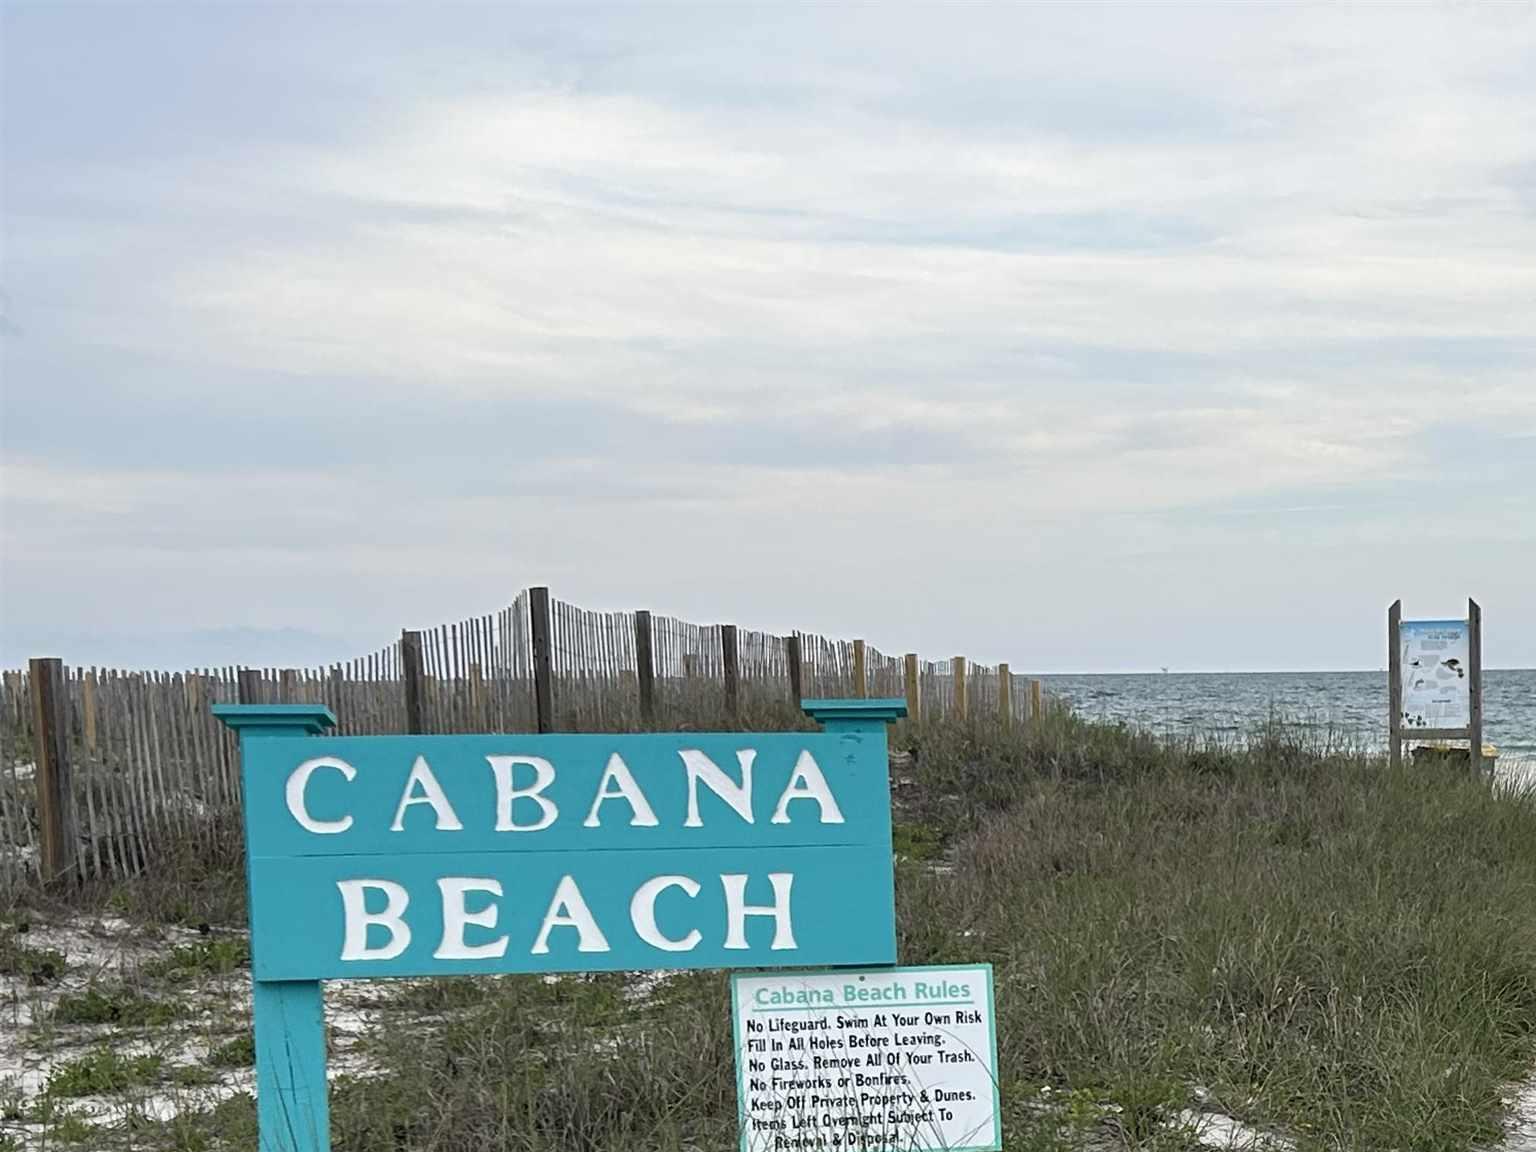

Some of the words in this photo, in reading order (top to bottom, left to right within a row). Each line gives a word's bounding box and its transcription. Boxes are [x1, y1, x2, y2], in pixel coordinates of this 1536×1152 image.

[285, 749, 845, 835] CABANA
[336, 872, 798, 962] BEACH
[754, 986, 834, 1006] Cabana
[844, 982, 906, 1002] Beach
[915, 980, 970, 1000] Rules
[747, 1019, 764, 1033] No
[768, 1016, 831, 1034] Lifeguard.
[837, 1014, 869, 1029] Swim
[874, 1013, 887, 1027] At
[892, 1012, 919, 1027] Your
[925, 1011, 950, 1025] Own
[956, 1010, 982, 1024] Risk
[748, 1037, 766, 1052] Fill
[771, 1036, 783, 1051] In
[788, 1035, 804, 1050] All
[809, 1034, 843, 1049] Holes
[849, 1033, 889, 1048] Before
[894, 1032, 946, 1047] Leaving.
[749, 1058, 765, 1072] No
[771, 1056, 809, 1071] Glass.
[814, 1055, 861, 1070] Remove
[866, 1053, 882, 1067] All
[886, 1052, 901, 1066] Of
[906, 1051, 933, 1065] Your
[938, 1049, 975, 1063] Trash.
[750, 1078, 767, 1092] No
[772, 1074, 832, 1091] Fireworks
[837, 1076, 850, 1088] or
[856, 1072, 911, 1087] Bonfires.
[752, 1097, 782, 1113] Keep
[787, 1095, 806, 1109] Off
[812, 1094, 855, 1108] Private
[861, 1091, 913, 1106] Property
[920, 1091, 929, 1103] &
[935, 1089, 976, 1102] Dunes.
[752, 1117, 787, 1131] Items
[792, 1114, 818, 1129] Left
[823, 1112, 882, 1127] Overnight
[888, 1109, 934, 1125] Subject
[938, 1108, 953, 1122] To
[832, 1133, 842, 1146] &
